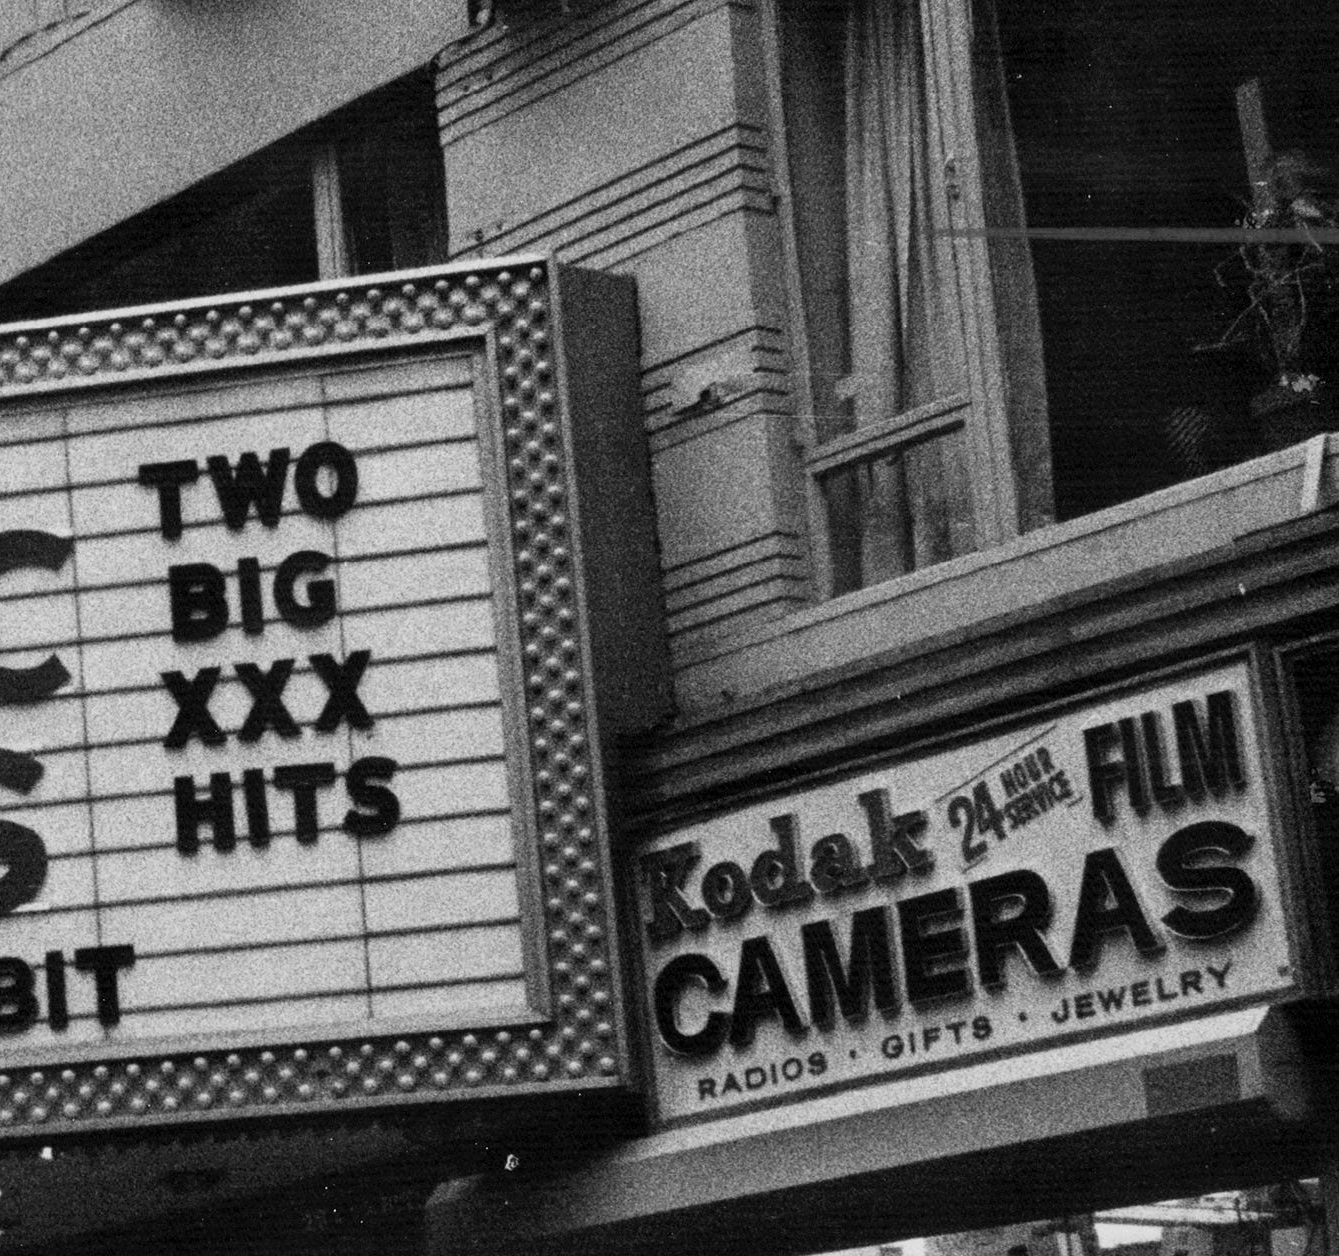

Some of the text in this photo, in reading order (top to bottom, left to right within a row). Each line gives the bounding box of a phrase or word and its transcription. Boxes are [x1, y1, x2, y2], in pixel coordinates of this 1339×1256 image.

[139, 440, 358, 542] TWO
[168, 550, 336, 643] BIG
[161, 650, 374, 749] XXX
[174, 756, 401, 857] HITS
[639, 690, 1248, 948] Kodak 24 FILM
[999, 747, 1056, 798] HOUR
[1003, 769, 1074, 830] SERVICE
[654, 820, 1264, 1057] CAMERAS
[698, 959, 1235, 1101] RADIOS GIFTS JEWELRY
